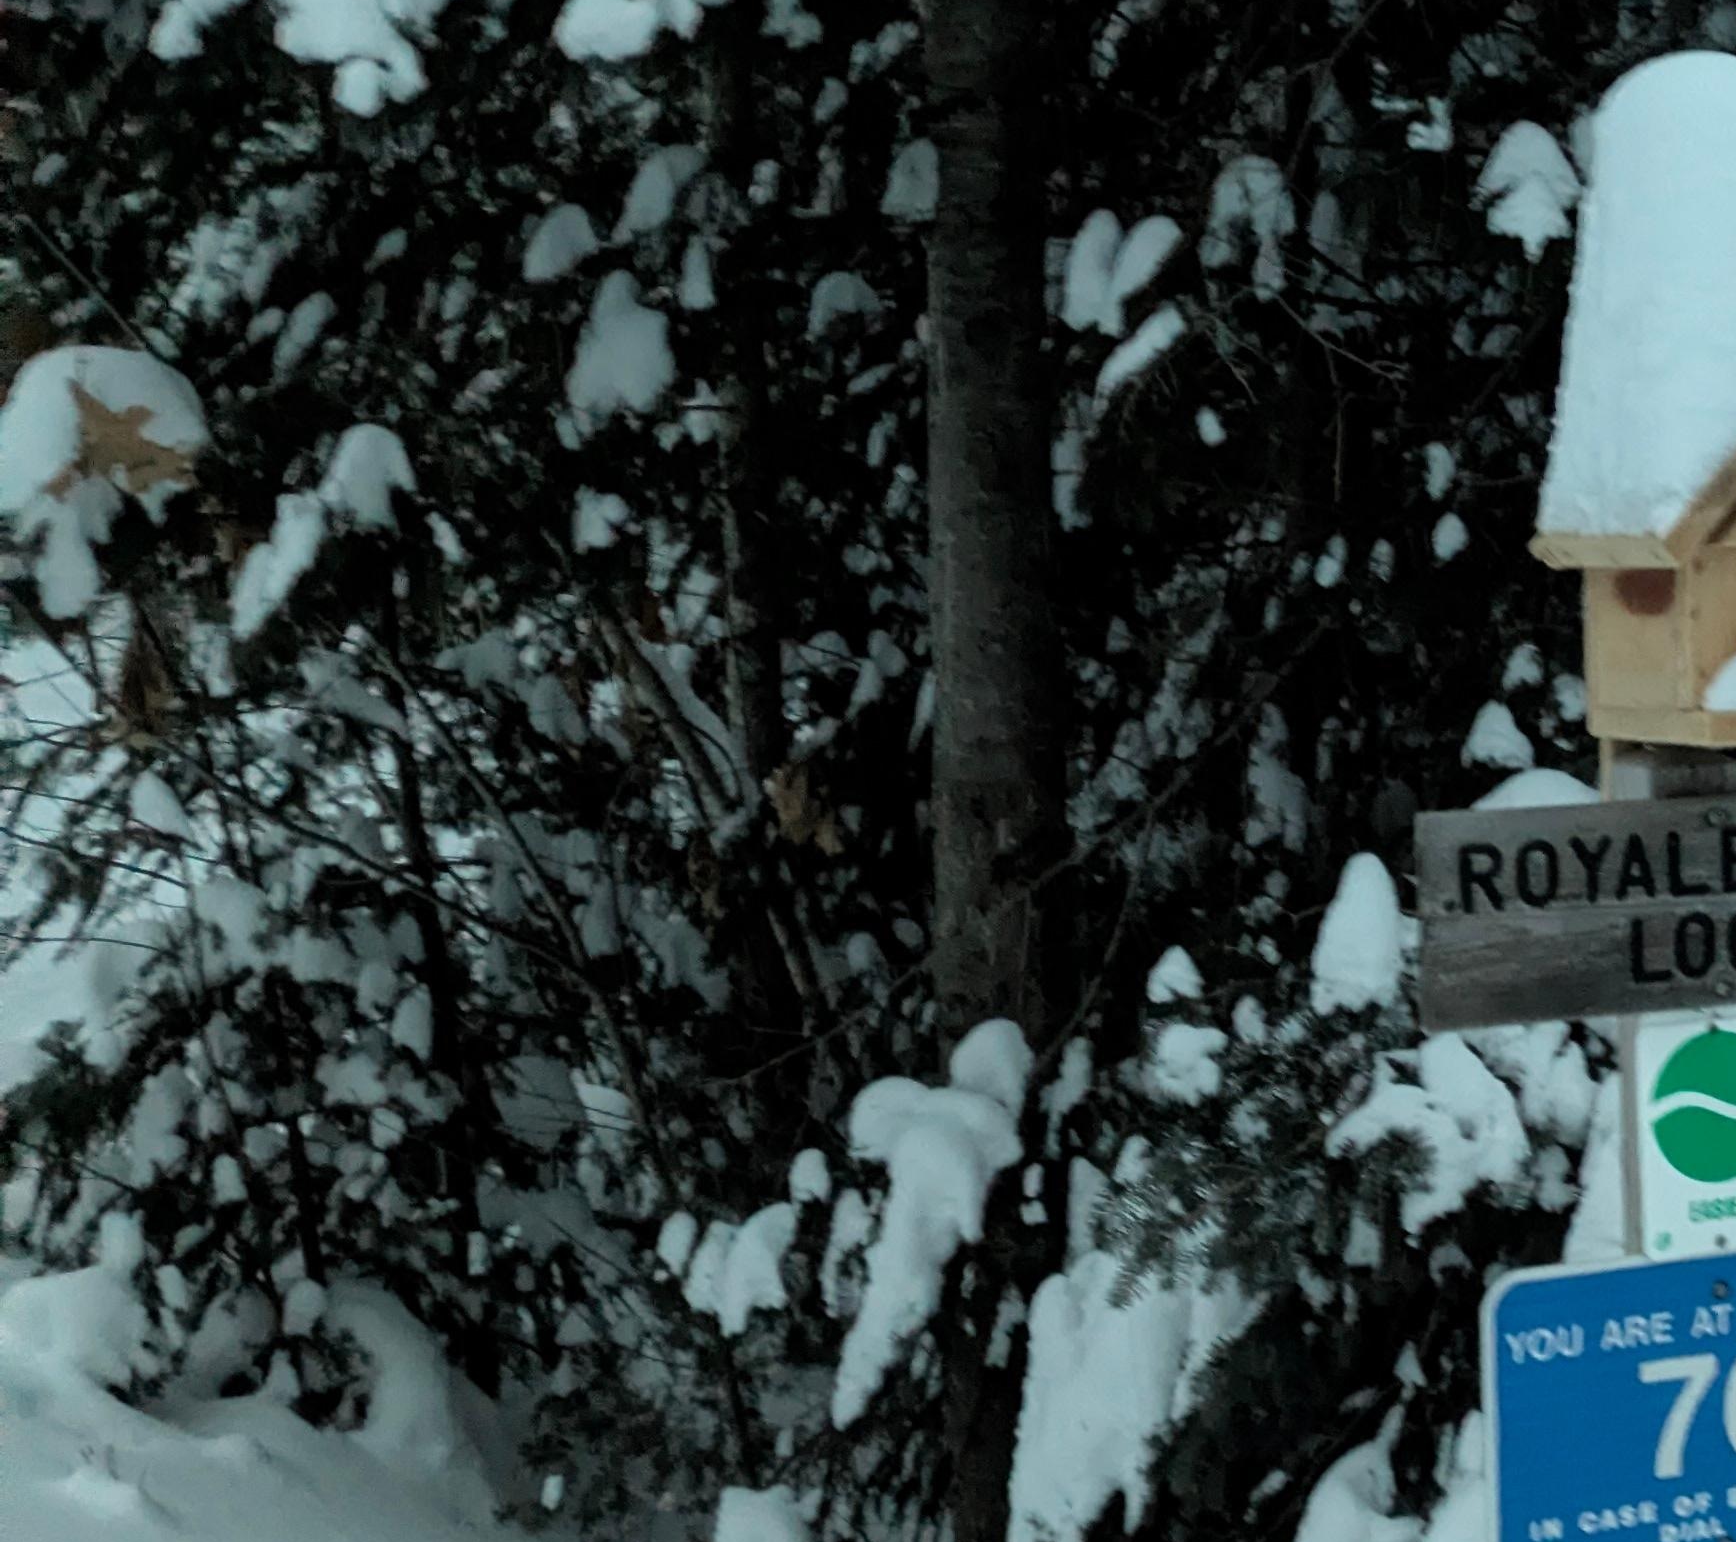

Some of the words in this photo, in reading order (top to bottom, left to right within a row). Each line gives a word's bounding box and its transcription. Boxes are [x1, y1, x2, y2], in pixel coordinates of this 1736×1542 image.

[1504, 1324, 1584, 1364] YOU
[1601, 1311, 1675, 1351] ARE
[1690, 1303, 1734, 1338] AT
[1529, 1518, 1563, 1542] IN
[1578, 1499, 1659, 1534] CASE
[1673, 1491, 1713, 1518] OF
